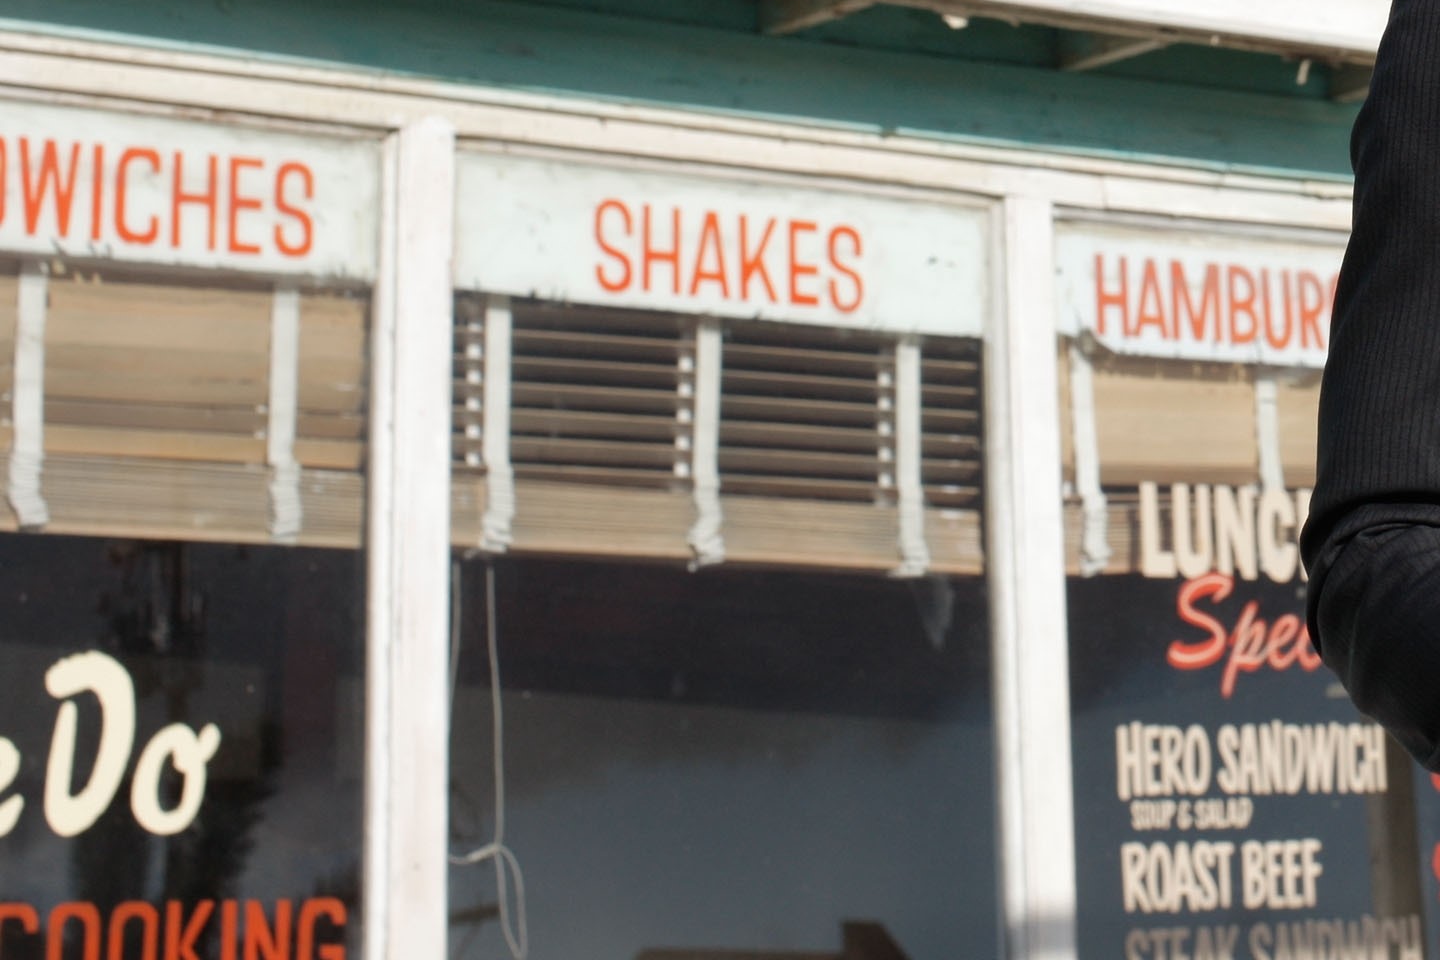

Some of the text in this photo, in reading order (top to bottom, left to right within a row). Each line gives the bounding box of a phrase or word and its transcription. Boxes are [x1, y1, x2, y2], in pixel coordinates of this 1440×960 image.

[0, 135, 314, 256] WICHES
[594, 198, 863, 314] SHAKES
[1094, 253, 1341, 350] HAMBUR
[44, 649, 221, 838] Do
[1116, 720, 1387, 800] HERO SANDWICH
[1121, 839, 1322, 912] ROAST BEEF
